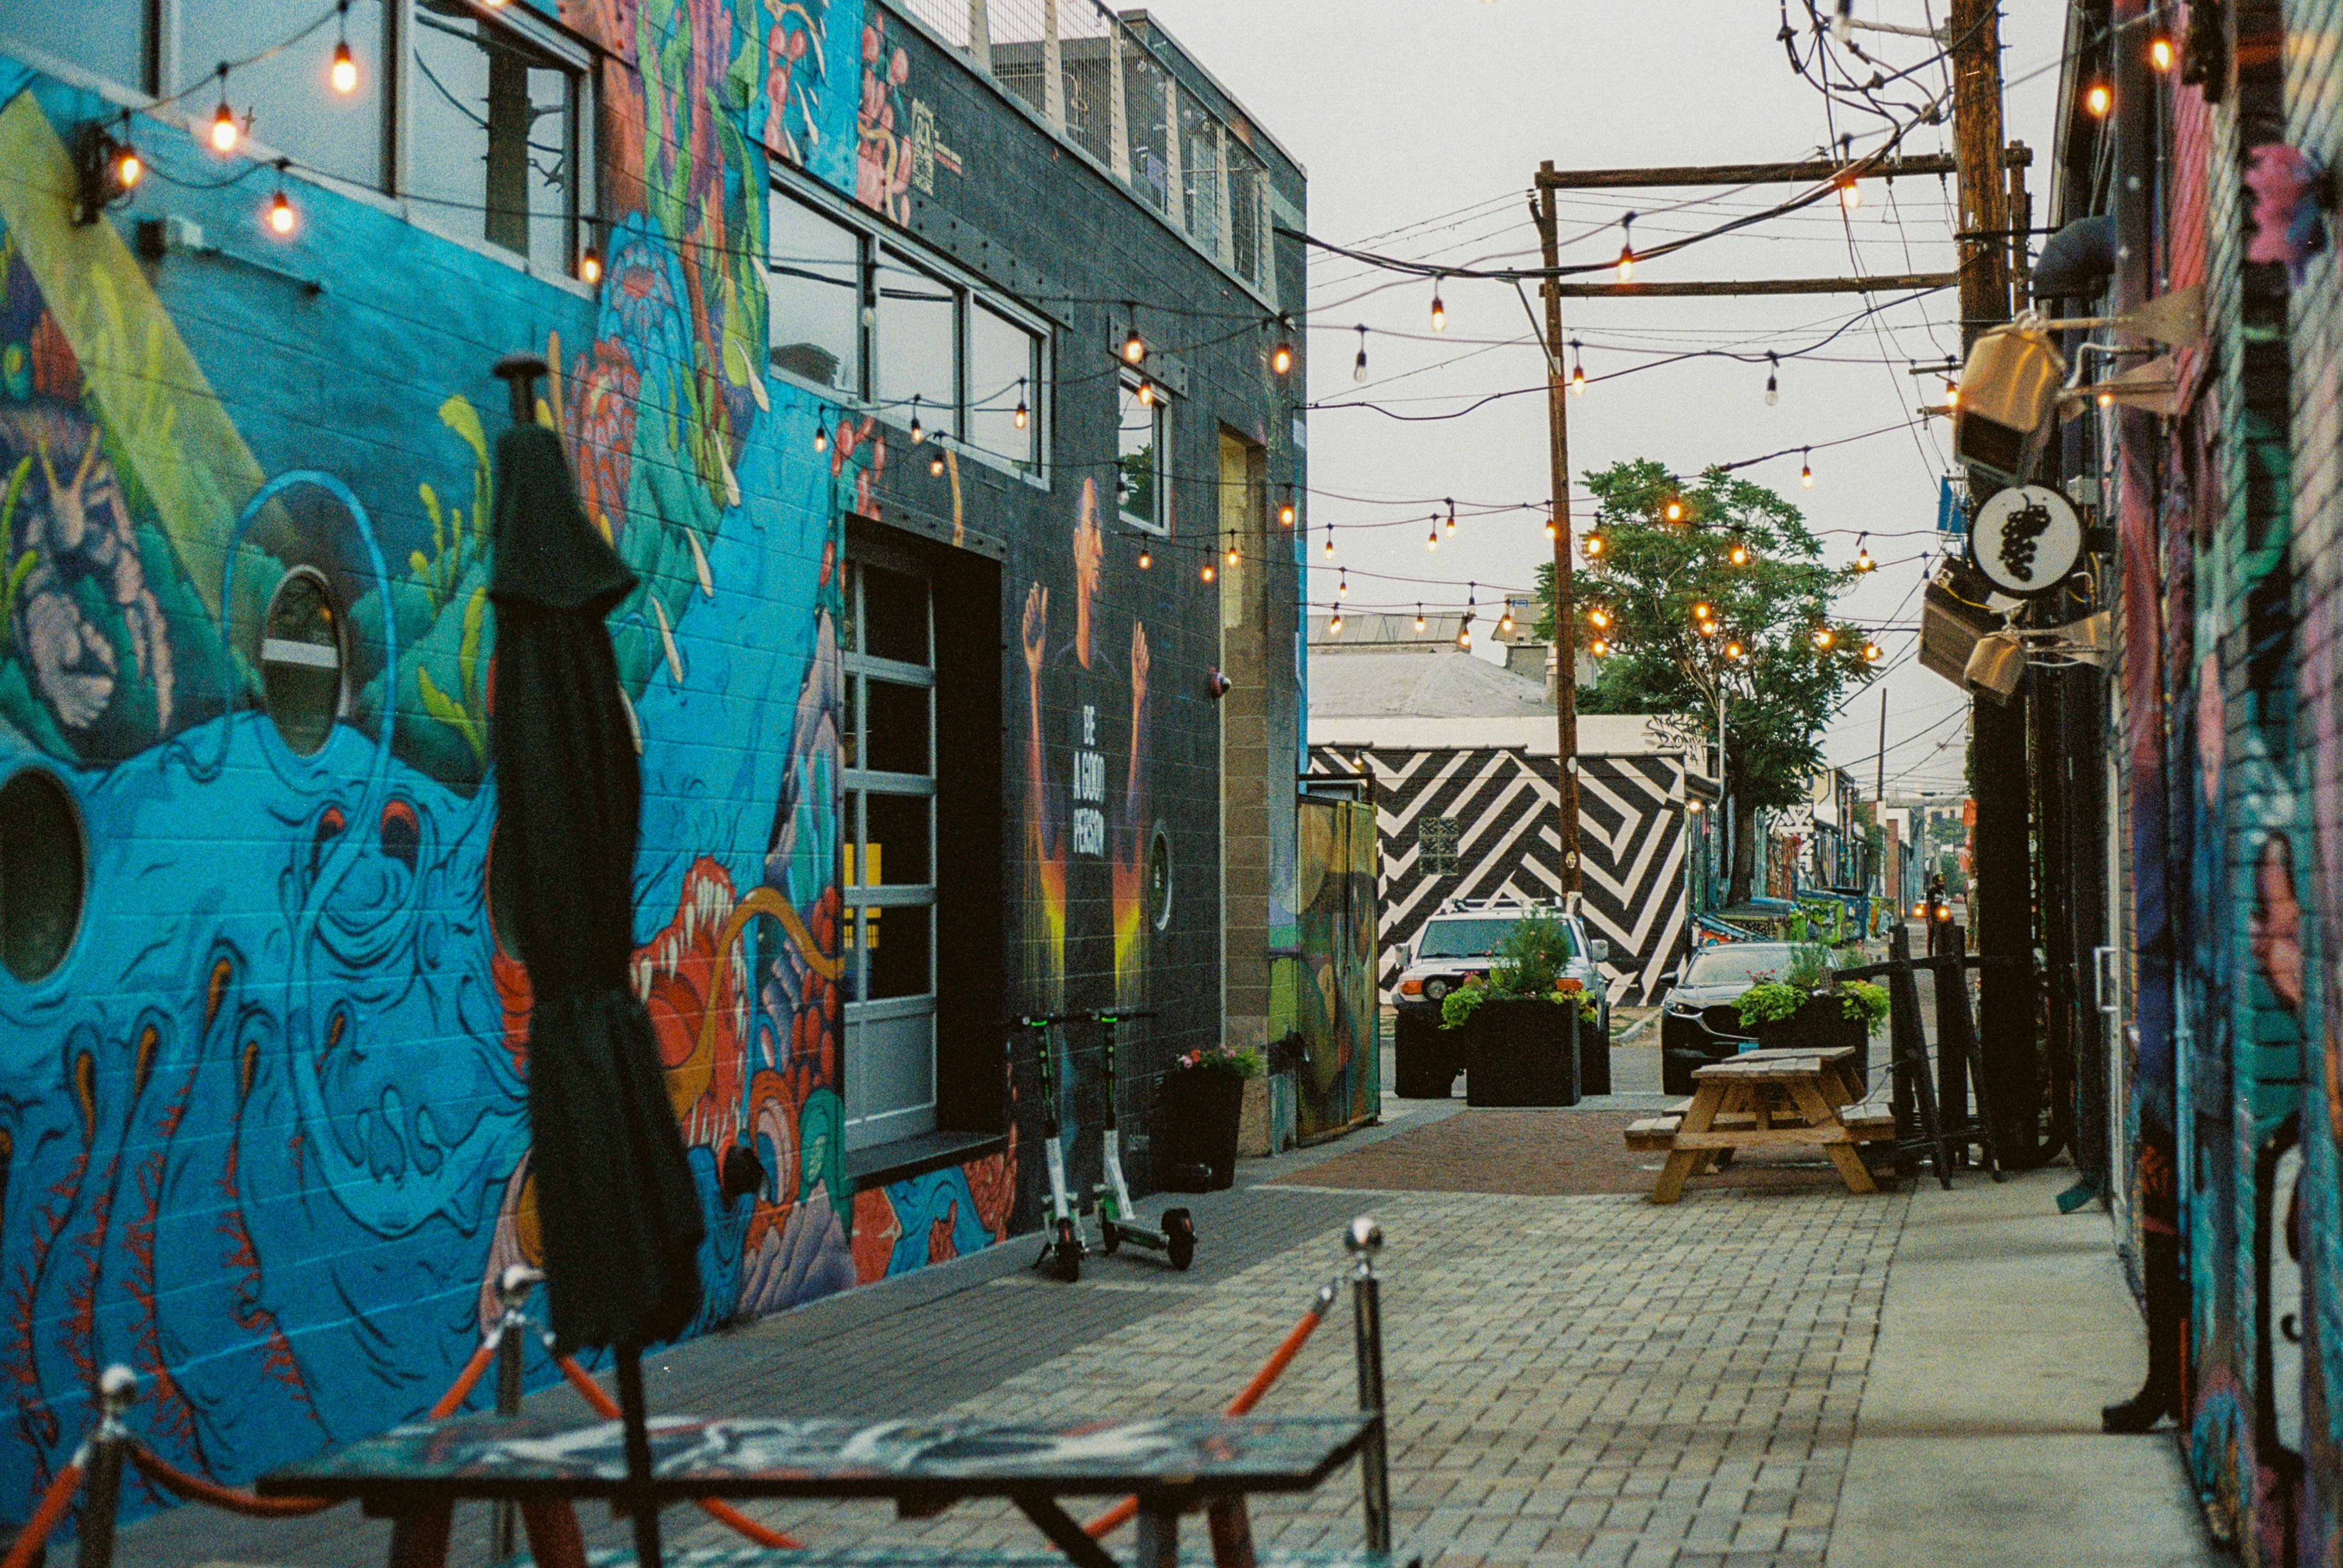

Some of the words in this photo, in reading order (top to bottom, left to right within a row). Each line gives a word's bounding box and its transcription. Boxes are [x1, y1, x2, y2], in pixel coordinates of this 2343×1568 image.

[1084, 705, 1095, 745] BE
[1074, 751, 1080, 799] A
[1082, 752, 1104, 803] GOOD
[1074, 807, 1104, 858] PERSON
